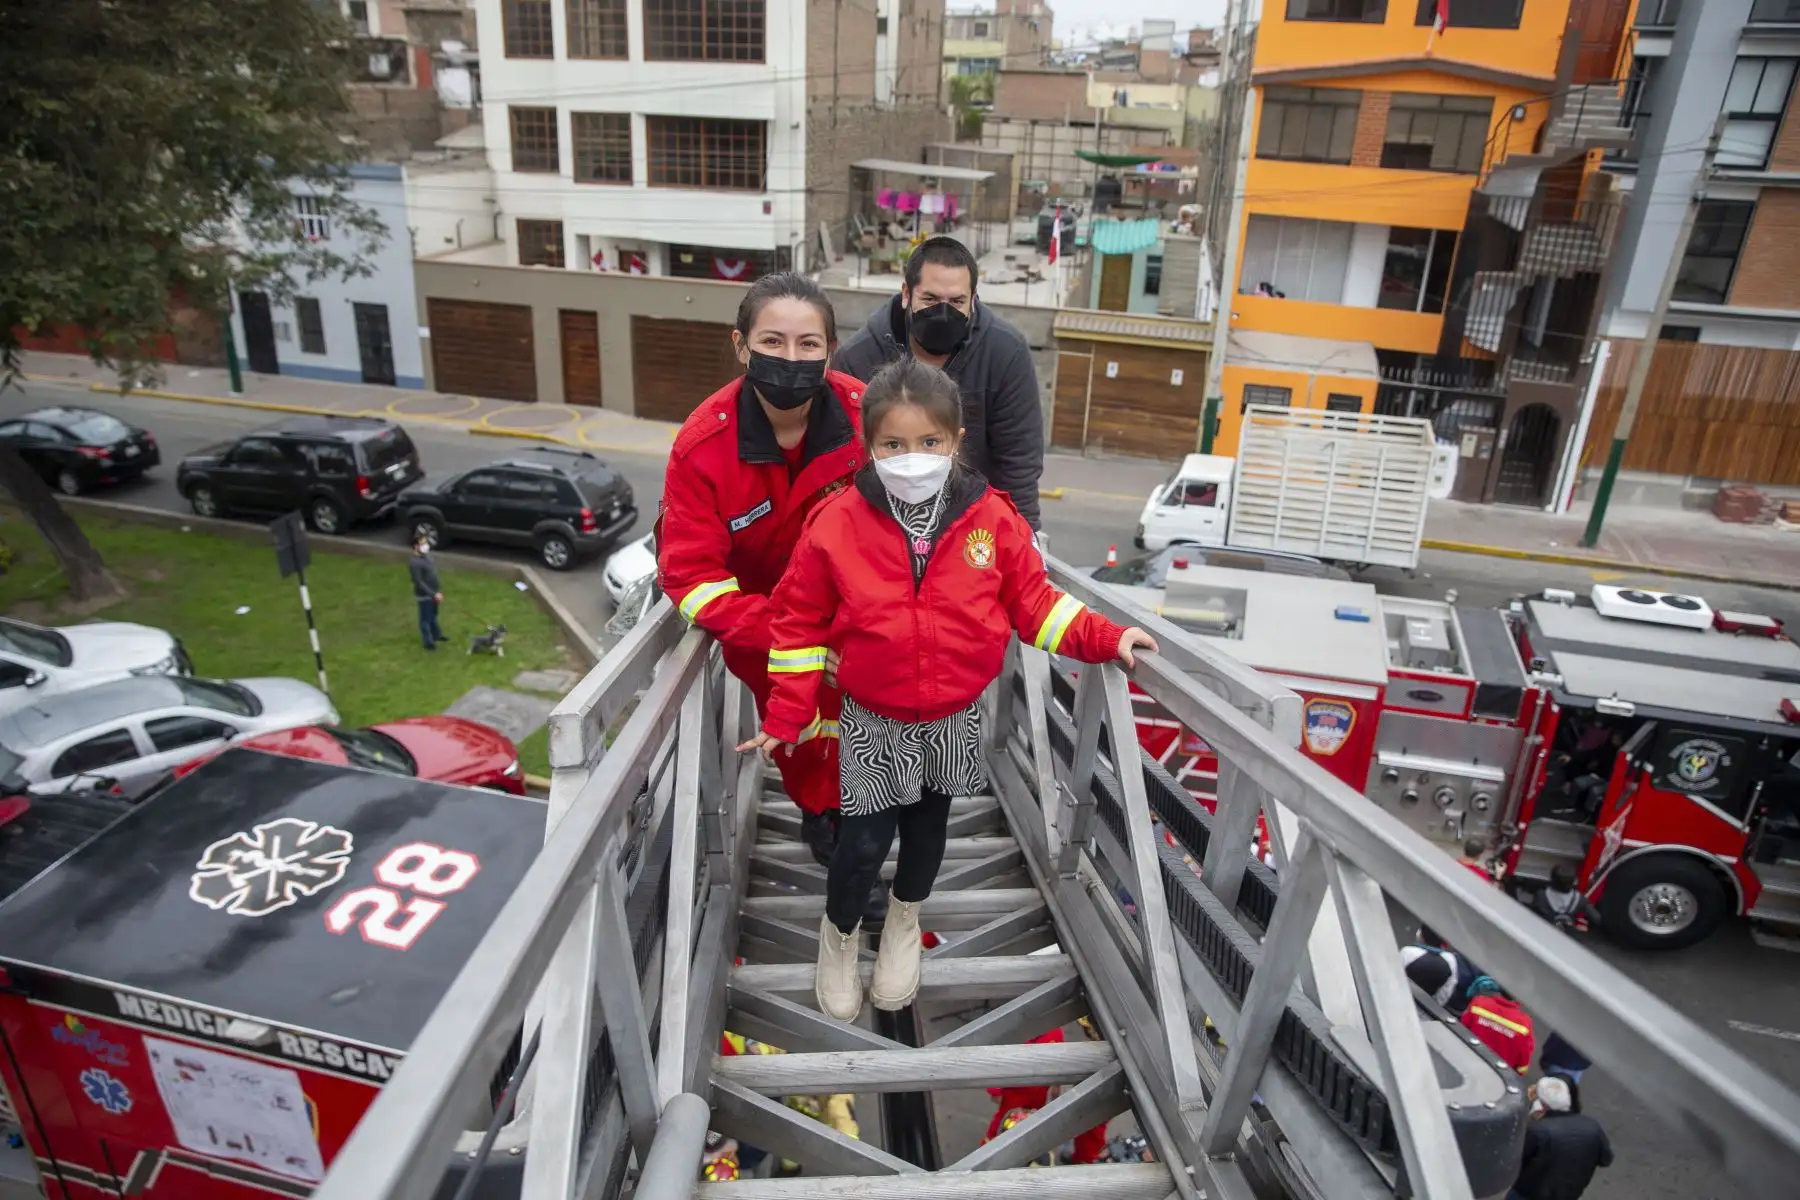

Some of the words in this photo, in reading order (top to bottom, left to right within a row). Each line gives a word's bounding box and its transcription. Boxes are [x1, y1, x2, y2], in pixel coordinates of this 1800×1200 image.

[734, 520, 743, 528] M.
[324, 840, 482, 952] 28
[112, 990, 240, 1038] MEDICA
